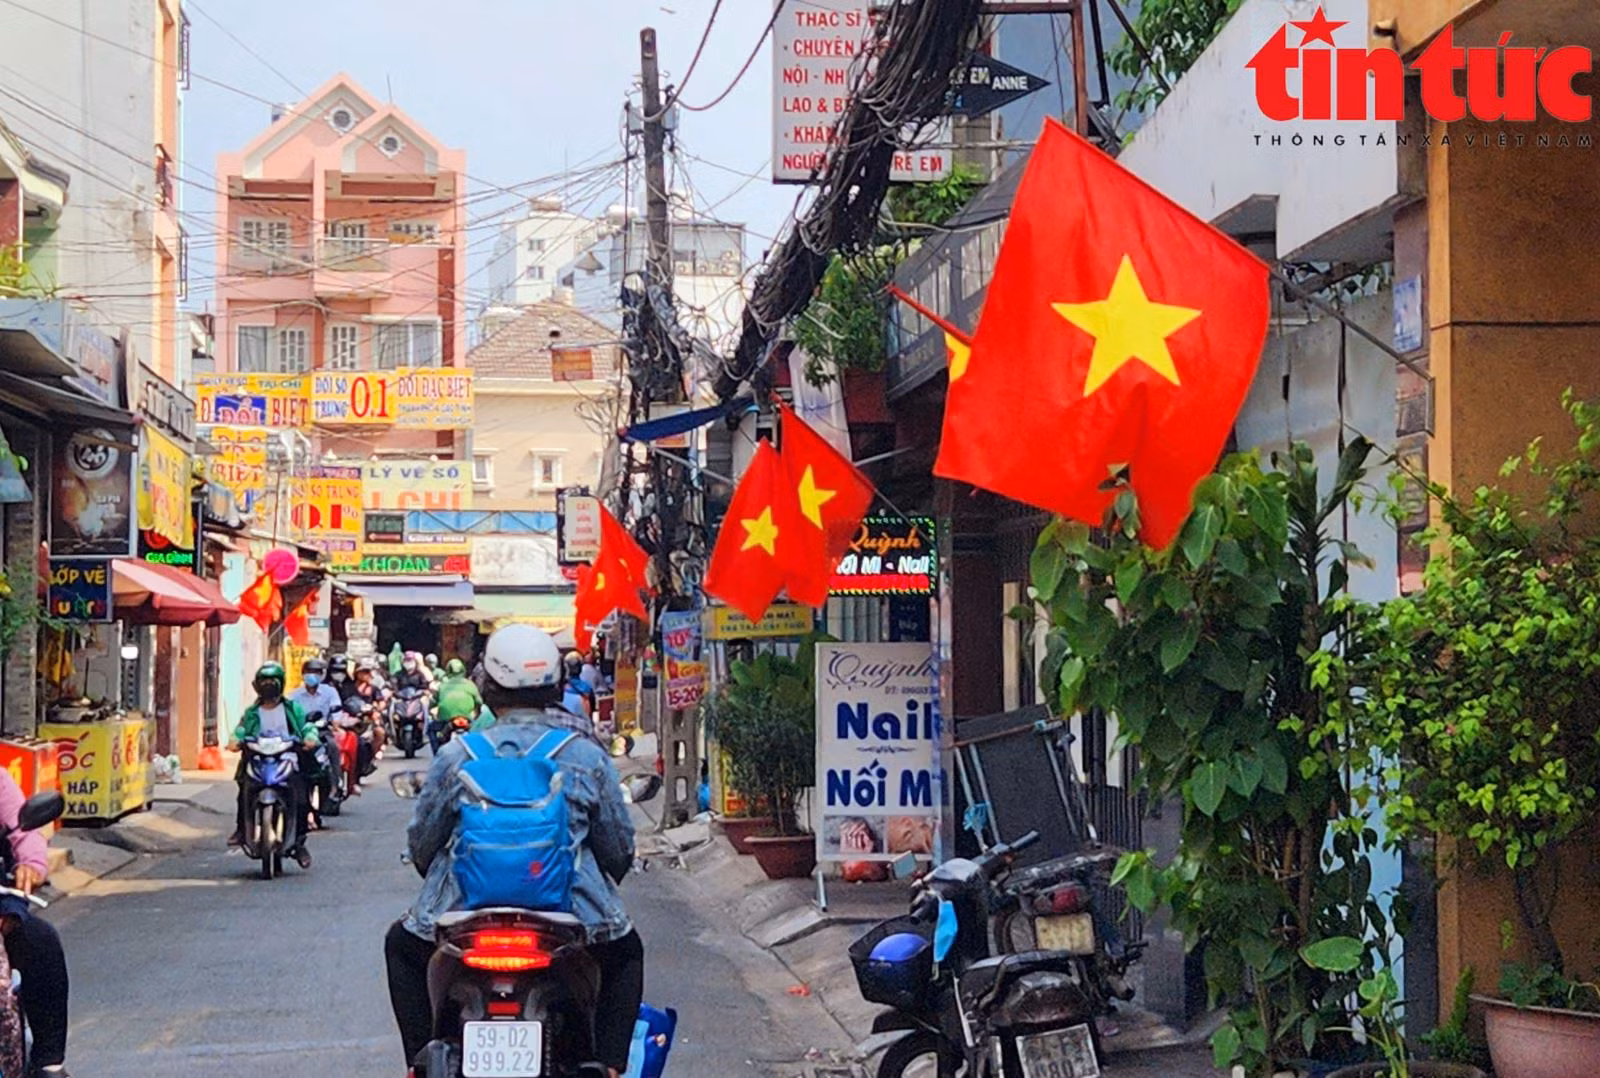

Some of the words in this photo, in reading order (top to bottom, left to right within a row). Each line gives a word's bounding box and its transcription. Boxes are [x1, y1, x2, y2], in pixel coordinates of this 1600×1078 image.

[795, 11, 840, 30] THẠC
[793, 35, 855, 56] CHUYÊN
[783, 63, 809, 87] NỘI
[992, 76, 1028, 90] ANNE
[783, 97, 811, 113] LAO
[920, 156, 942, 171] EM
[827, 758, 888, 807] Nối
[469, 1051, 534, 1072] 999.22
